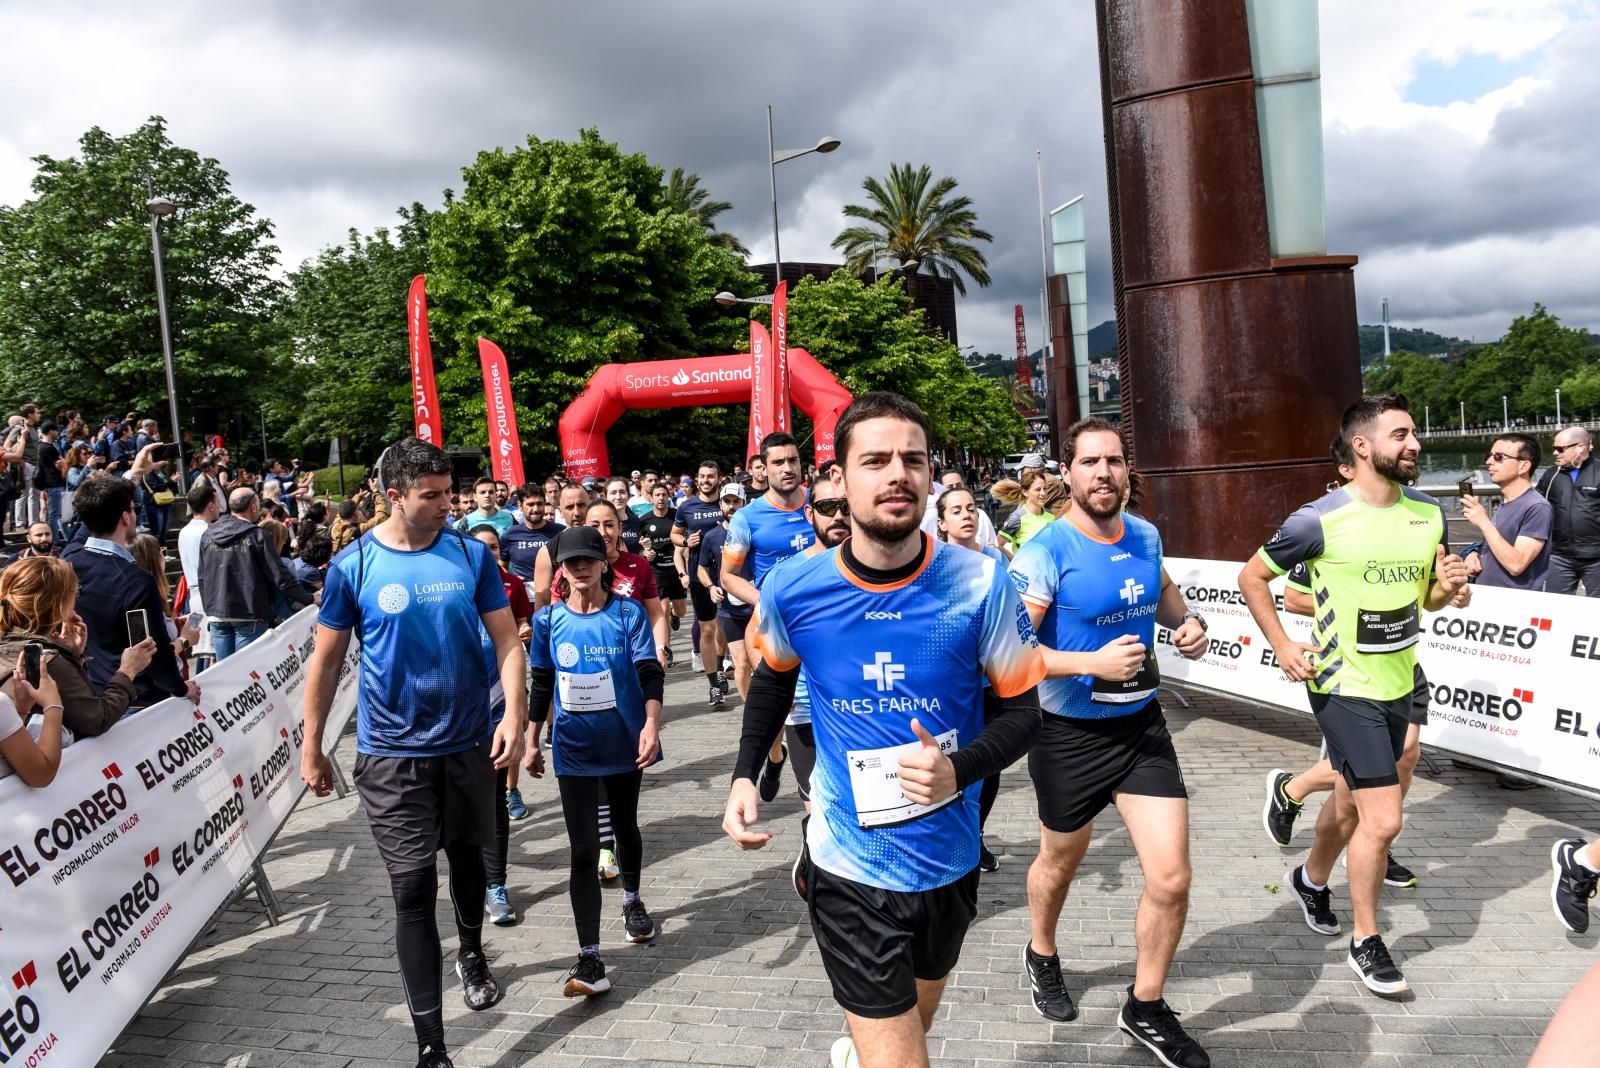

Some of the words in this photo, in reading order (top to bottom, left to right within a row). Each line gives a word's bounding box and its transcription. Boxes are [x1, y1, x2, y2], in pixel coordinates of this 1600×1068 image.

[625, 373, 670, 391] Sports
[691, 366, 752, 384] Santand
[703, 510, 722, 519] sene
[414, 581, 465, 595] Lontana
[416, 595, 443, 604] Group
[1096, 611, 1124, 626] FAES
[1432, 616, 1538, 650] CORREO
[584, 644, 624, 655] Lontana
[1208, 638, 1242, 659] REO
[1427, 641, 1478, 656] INFORMAZIO
[1479, 650, 1532, 665] BALIOTSUA
[211, 708, 235, 733] EL
[226, 682, 266, 721] CORREO
[832, 699, 873, 714] FAES
[879, 697, 941, 713] FARMA
[1469, 719, 1488, 730] CON
[1489, 724, 1518, 737] VALOR
[1554, 708, 1589, 737] EL
[135, 758, 166, 791] EL
[158, 722, 214, 774] CORREO
[249, 772, 264, 800] EL
[261, 741, 290, 787] CORREO
[0, 844, 40, 887] EL
[34, 782, 127, 861] CORREO
[172, 840, 195, 876] EL
[194, 792, 244, 855] CORREO
[52, 840, 104, 885] INFORMACIÓN
[103, 829, 119, 847] CON
[119, 813, 140, 834] VALOR
[56, 946, 91, 993] EL
[82, 871, 160, 961] CORREO
[100, 937, 141, 985] INFORMAZIO
[140, 902, 173, 939] BALIOTSUA
